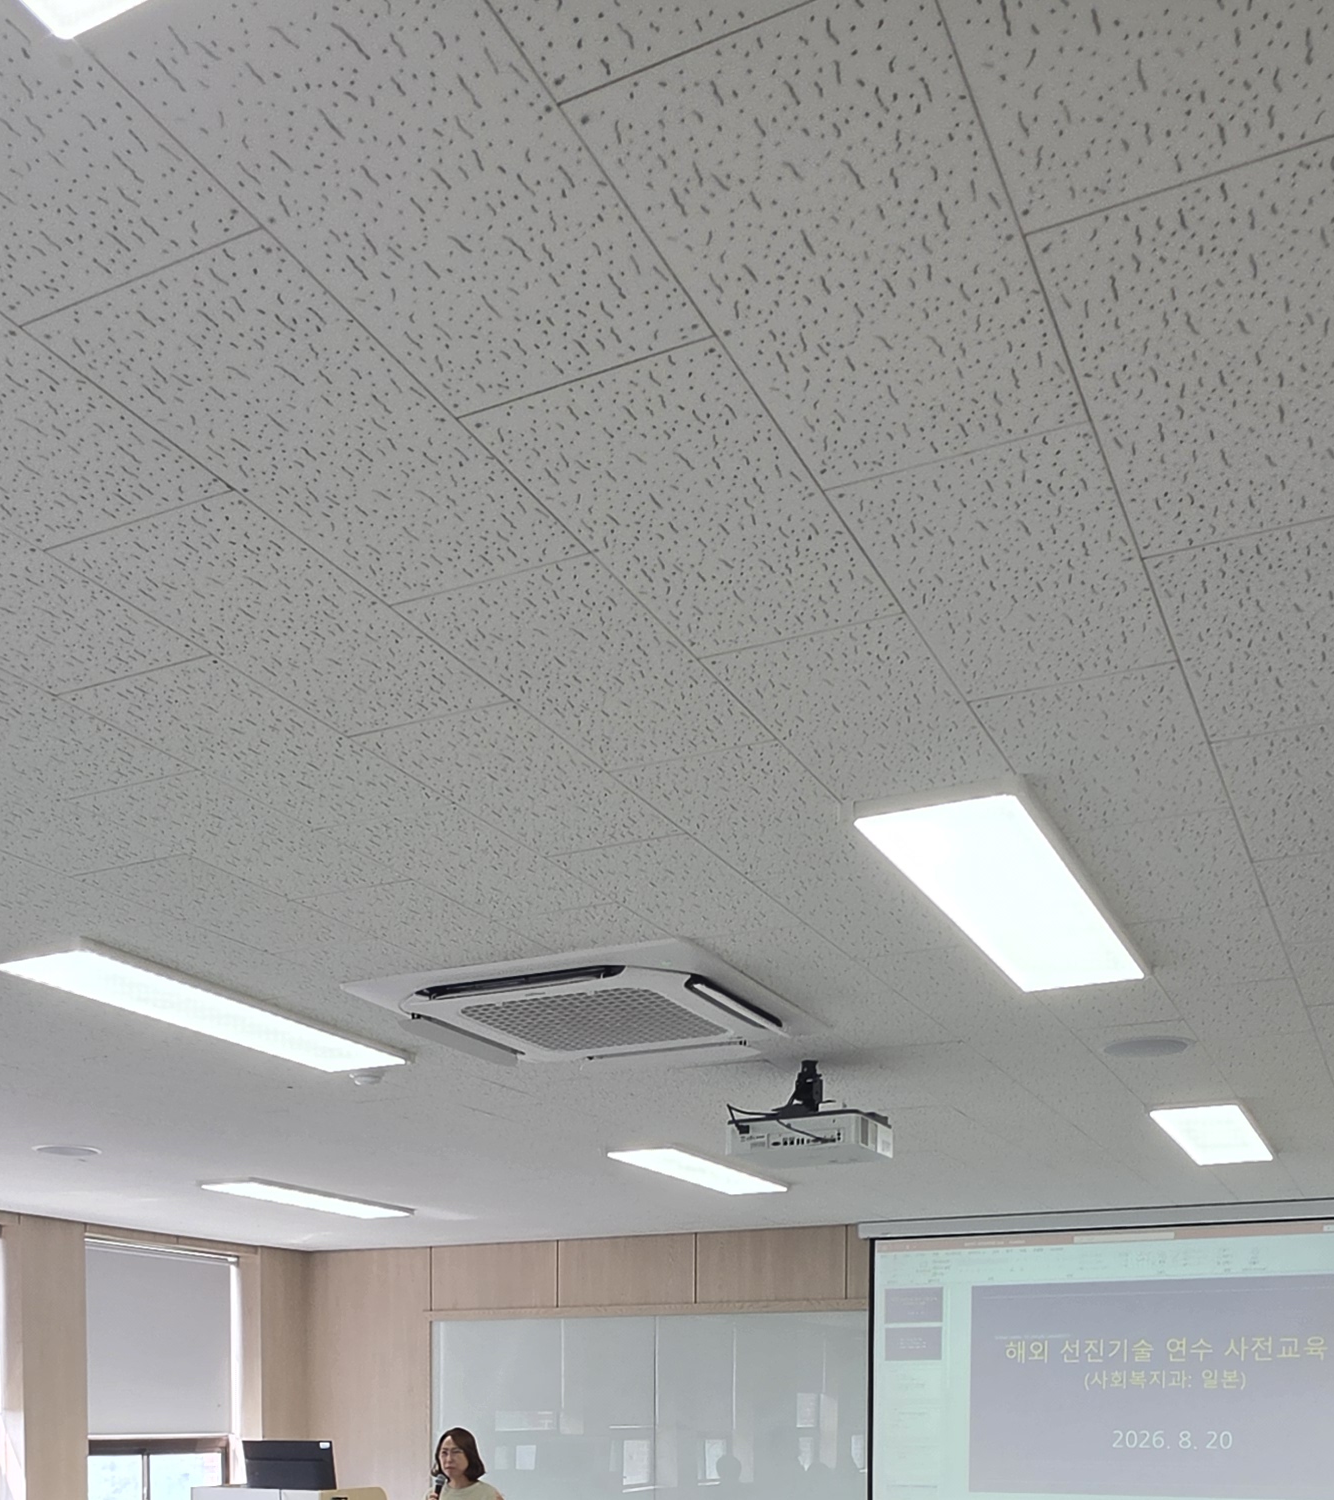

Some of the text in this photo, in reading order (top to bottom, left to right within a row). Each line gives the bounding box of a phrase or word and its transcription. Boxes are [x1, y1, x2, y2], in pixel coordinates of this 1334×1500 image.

[1005, 1336, 1328, 1364] 해외 선진기술 연수 사전교육
[1084, 1369, 1247, 1391] (사회복지과: 일본)
[1112, 1430, 1233, 1450] 2026. 8. 20
